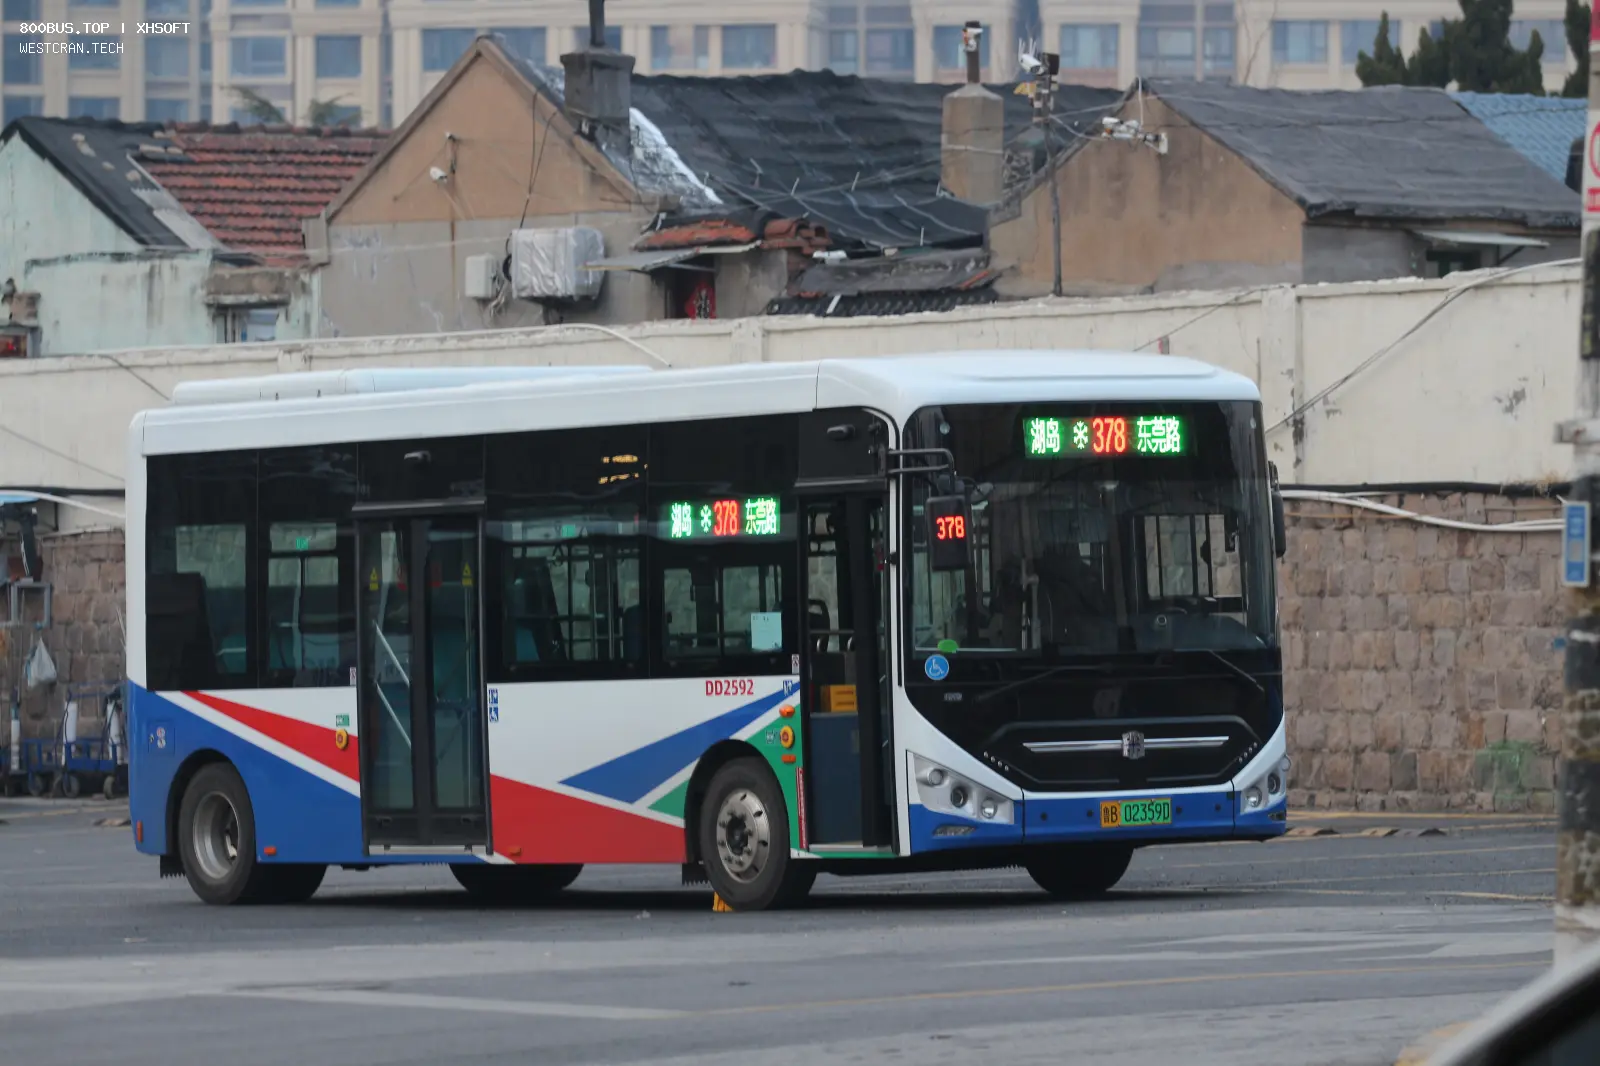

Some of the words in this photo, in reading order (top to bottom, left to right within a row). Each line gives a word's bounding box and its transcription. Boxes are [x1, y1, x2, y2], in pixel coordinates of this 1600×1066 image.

[1030, 417, 1060, 454] 湖岛
[1092, 417, 1126, 453] 378
[1136, 415, 1181, 453] 东莞路
[713, 500, 738, 536] 378
[745, 498, 777, 535] 东莞路
[936, 515, 965, 540] 378
[705, 679, 754, 696] DD2592
[1124, 802, 1170, 822] 02359D
